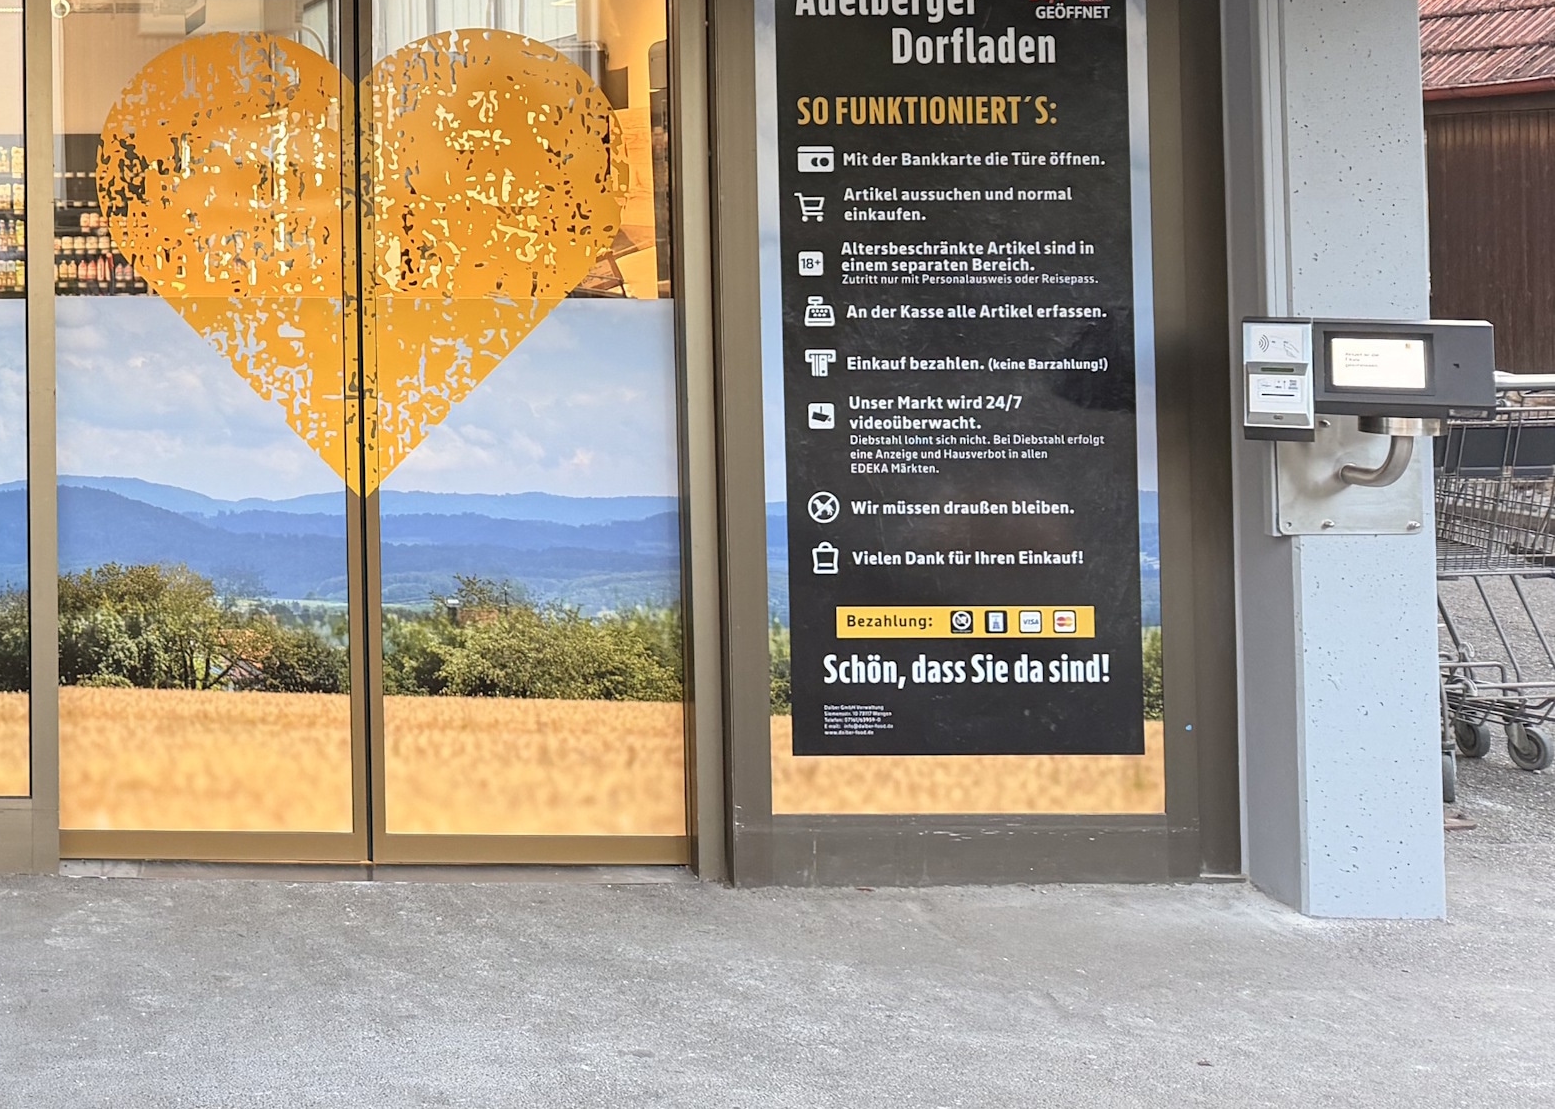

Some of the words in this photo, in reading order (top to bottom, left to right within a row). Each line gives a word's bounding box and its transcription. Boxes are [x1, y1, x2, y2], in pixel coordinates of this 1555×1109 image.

[1035, 3, 1111, 19] GEÖFFNET
[891, 27, 1057, 64] Dorfladen
[796, 97, 829, 125] SO
[844, 152, 868, 165] Mit
[872, 153, 897, 165] der
[902, 153, 981, 165] Bankkarte
[985, 152, 1008, 165] die
[1012, 152, 1046, 165] Türe
[1050, 152, 1105, 165] öffnen.
[844, 187, 897, 201] Artikel
[902, 188, 980, 200] aussuchen
[985, 187, 1013, 200] und
[1018, 187, 1072, 200] normal
[845, 207, 926, 220] einkaufen.
[842, 241, 983, 254] Altersbeschränkte
[988, 241, 1040, 254] Artikel
[1045, 241, 1075, 254] sind
[1080, 241, 1093, 254] in
[801, 257, 821, 269] 18+
[842, 260, 887, 271] einem
[892, 259, 967, 274] separaten
[972, 258, 1034, 271] Bereich.
[842, 274, 878, 284] Zutritt
[881, 276, 898, 284] nur
[902, 274, 919, 284] mit
[922, 274, 1012, 284] Personalausweis
[1015, 274, 1039, 284] oder
[1042, 274, 1098, 286] Reisepass.
[847, 305, 866, 318] An
[871, 305, 896, 318] der
[901, 305, 943, 318] Kasse
[948, 305, 975, 318] alle
[980, 304, 1032, 318] Artikel
[1037, 305, 1106, 318] erfassen.
[847, 356, 906, 370] Einkauf
[910, 357, 984, 370] bezahlen.
[988, 358, 1025, 371] (keine
[1029, 358, 1108, 372] Barzahlung!)
[849, 396, 894, 409] Unser
[898, 396, 943, 409] Markt
[947, 395, 982, 409] wird
[986, 395, 1022, 411] 24/7
[850, 416, 981, 429] videoüberwacht.
[850, 435, 902, 445] Diebstahl
[905, 435, 933, 445] lohnt
[936, 435, 956, 445] sich
[960, 435, 990, 445] nicht.
[994, 435, 1010, 445] Bei
[1013, 435, 1064, 445] Diebstahl
[1068, 435, 1104, 446] erfolgt
[851, 450, 872, 459] eine
[876, 449, 918, 462] Anzeige
[921, 449, 940, 459] und
[944, 449, 1006, 459] Hausverbot
[1009, 449, 1018, 459] in
[1021, 449, 1047, 459] allen
[851, 464, 888, 473] EDEKA
[891, 463, 939, 473] Märkten.
[851, 501, 879, 514] Wir
[883, 501, 939, 514] müssen
[944, 501, 1007, 514] draußen
[1012, 500, 1074, 514] bleiben.
[853, 551, 901, 564] Vielen
[906, 551, 944, 564] Dank
[949, 551, 971, 564] für
[976, 551, 1014, 564] Ihren
[1019, 551, 1083, 564] Einkauf!
[847, 614, 933, 631] Bezahlung:
[824, 654, 906, 689] Schön,
[912, 655, 966, 683] dass
[971, 654, 1008, 683] Sie
[1014, 654, 1043, 683] da
[1049, 654, 1110, 683] sind!
